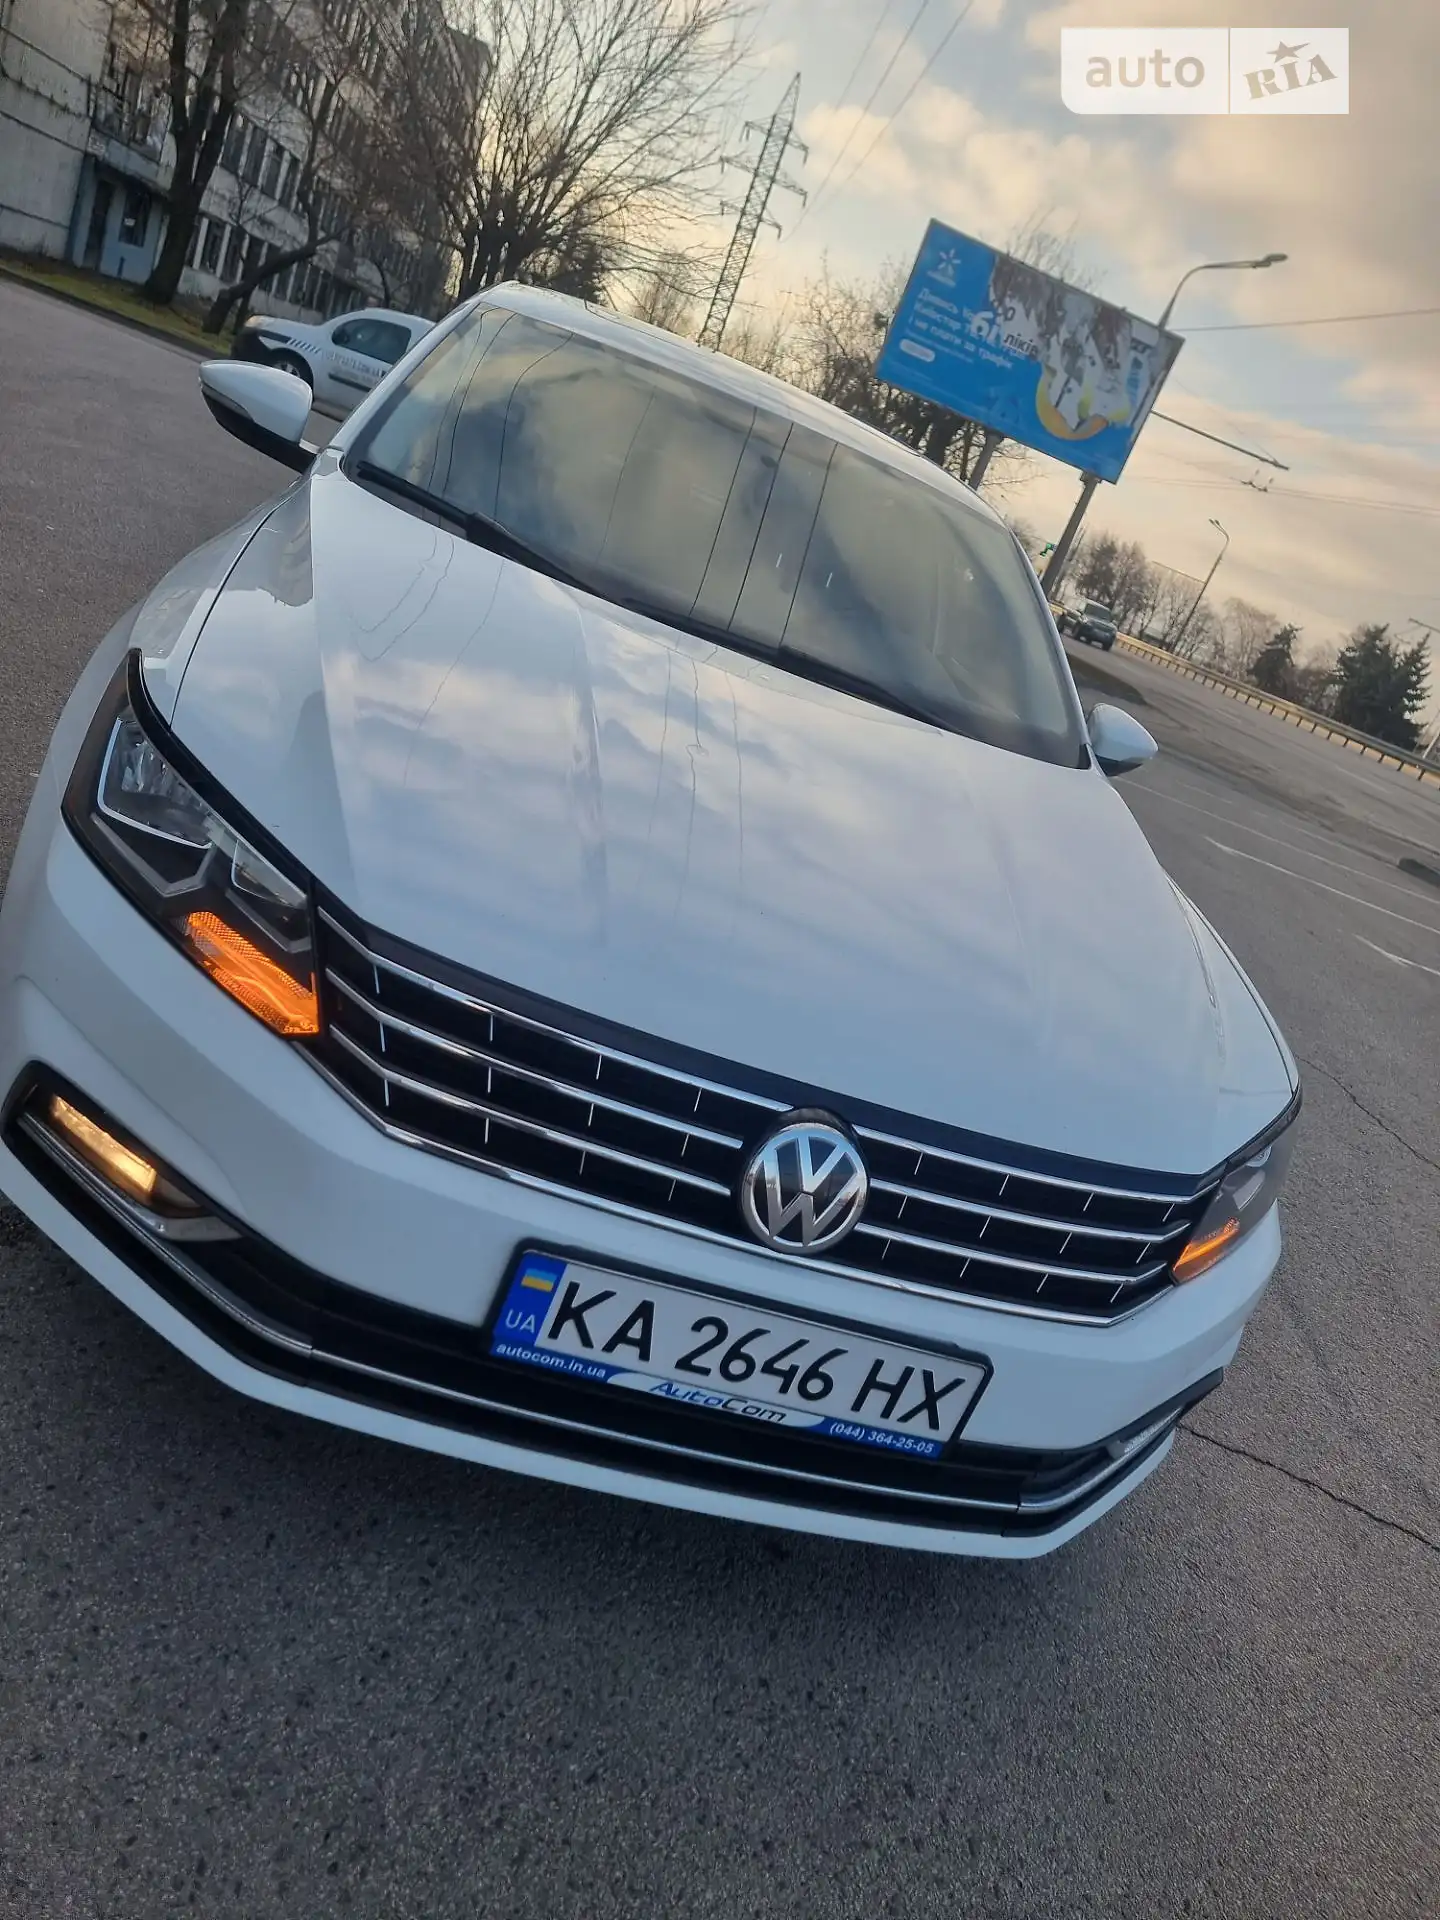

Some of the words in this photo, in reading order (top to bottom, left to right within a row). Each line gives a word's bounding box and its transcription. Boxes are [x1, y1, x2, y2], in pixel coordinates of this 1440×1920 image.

[505, 1308, 536, 1334] UA
[496, 1341, 607, 1379] autocom.in.ua
[548, 1280, 656, 1363] KA
[674, 1315, 849, 1401] 2646
[851, 1358, 966, 1431] HX
[650, 1381, 787, 1423] AutoCom
[829, 1422, 866, 1442] (044)
[867, 1431, 934, 1454] 364-25-05
